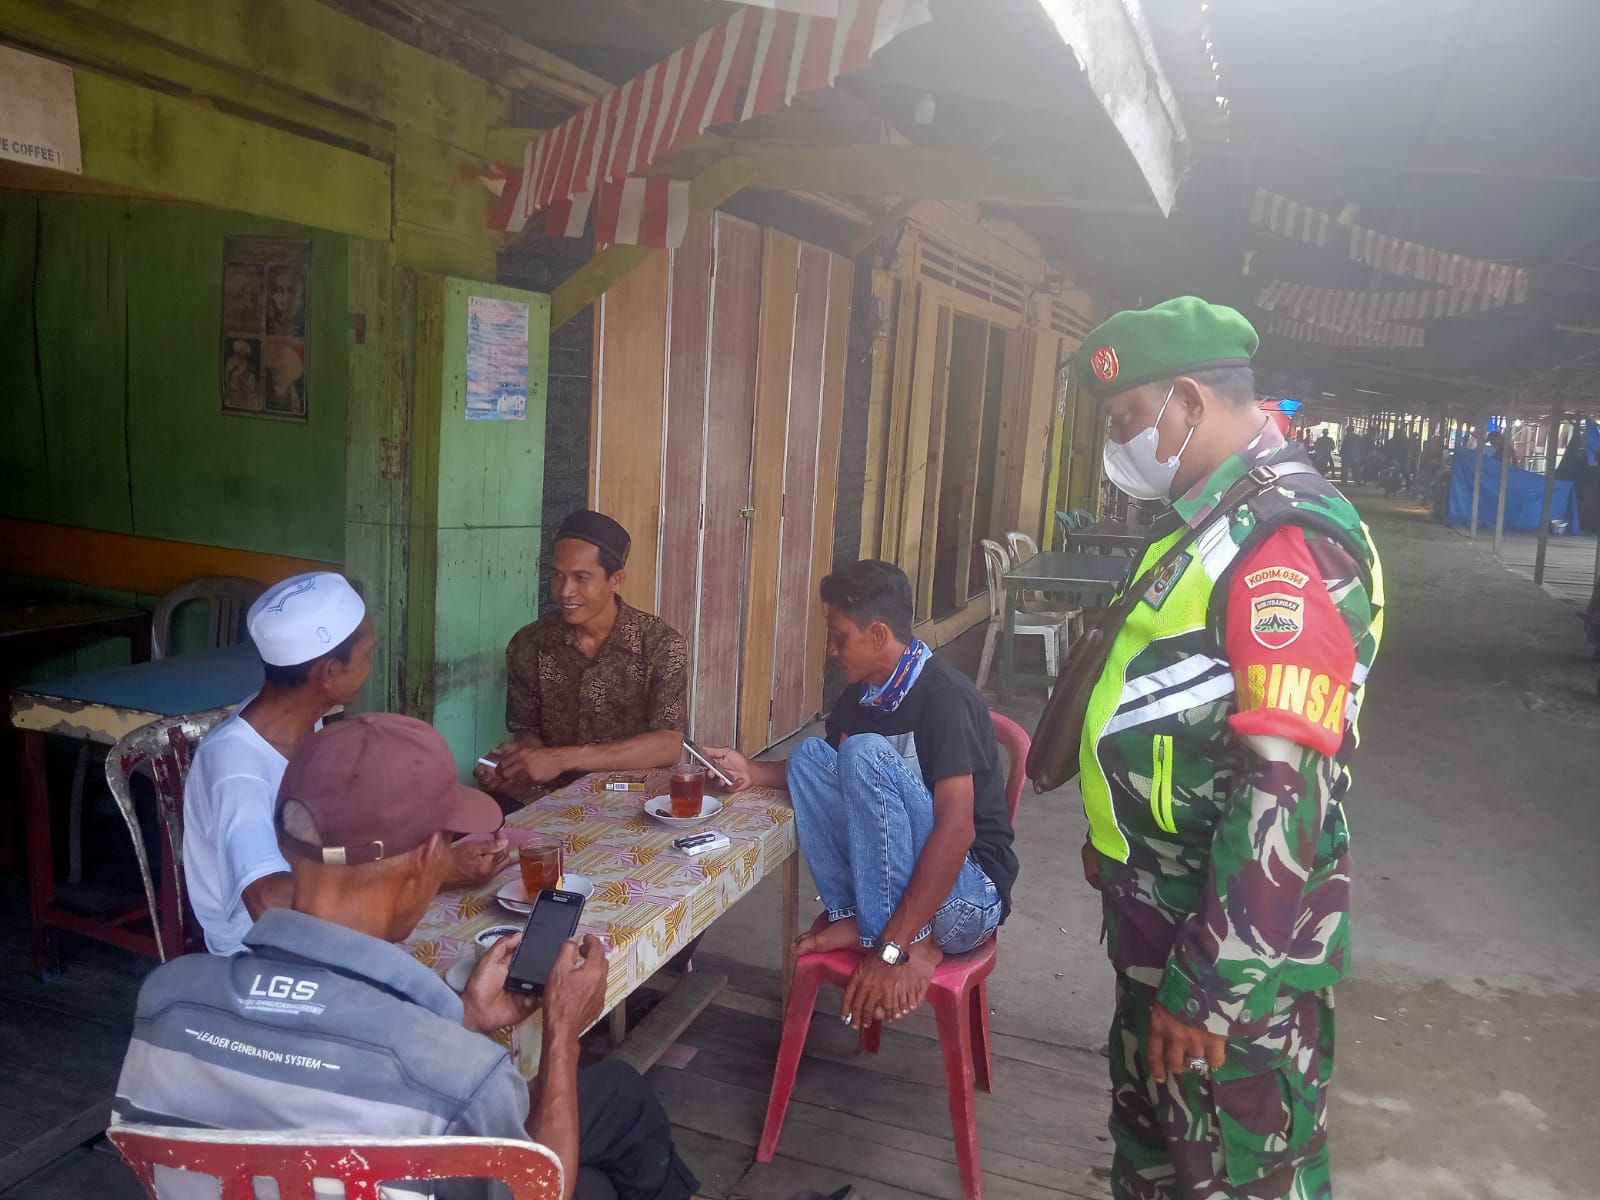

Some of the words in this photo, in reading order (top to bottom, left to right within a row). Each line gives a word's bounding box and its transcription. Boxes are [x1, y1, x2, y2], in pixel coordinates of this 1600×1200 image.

[12, 141, 54, 161] COFFEE
[1249, 569, 1281, 586] KODIM
[249, 974, 319, 1001] LGS
[197, 1031, 230, 1049] LEADER
[230, 1041, 284, 1063] GENERATION
[285, 1054, 322, 1070] SYSTEM
